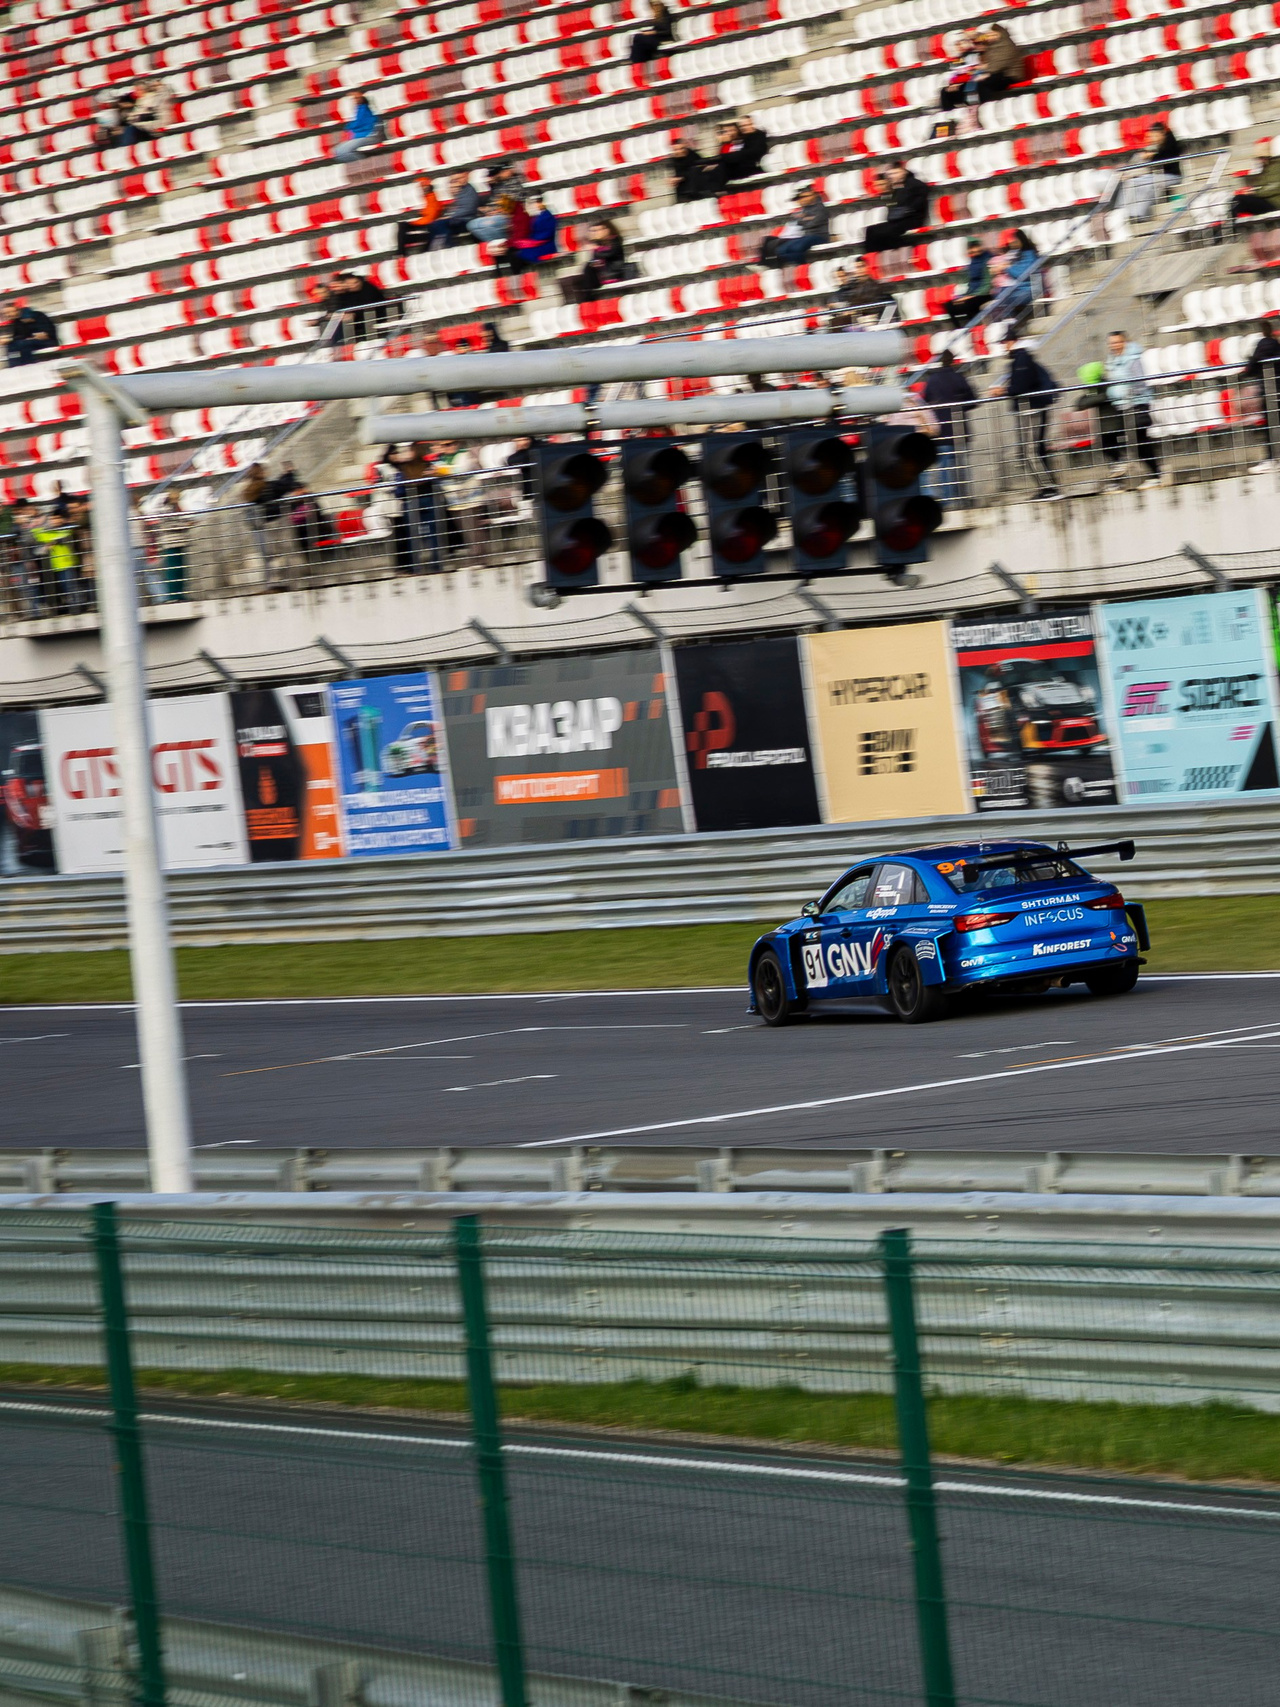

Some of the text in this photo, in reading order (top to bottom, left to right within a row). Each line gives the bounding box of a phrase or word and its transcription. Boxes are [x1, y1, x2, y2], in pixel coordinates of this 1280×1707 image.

[827, 672, 933, 706] HYPERCAR
[486, 696, 623, 758] КВАЗАР
[151, 738, 225, 794] GTS
[937, 859, 968, 874] 91
[1021, 894, 1080, 909] SHTURMAN
[805, 949, 826, 980] 91
[827, 942, 872, 978] GNV
